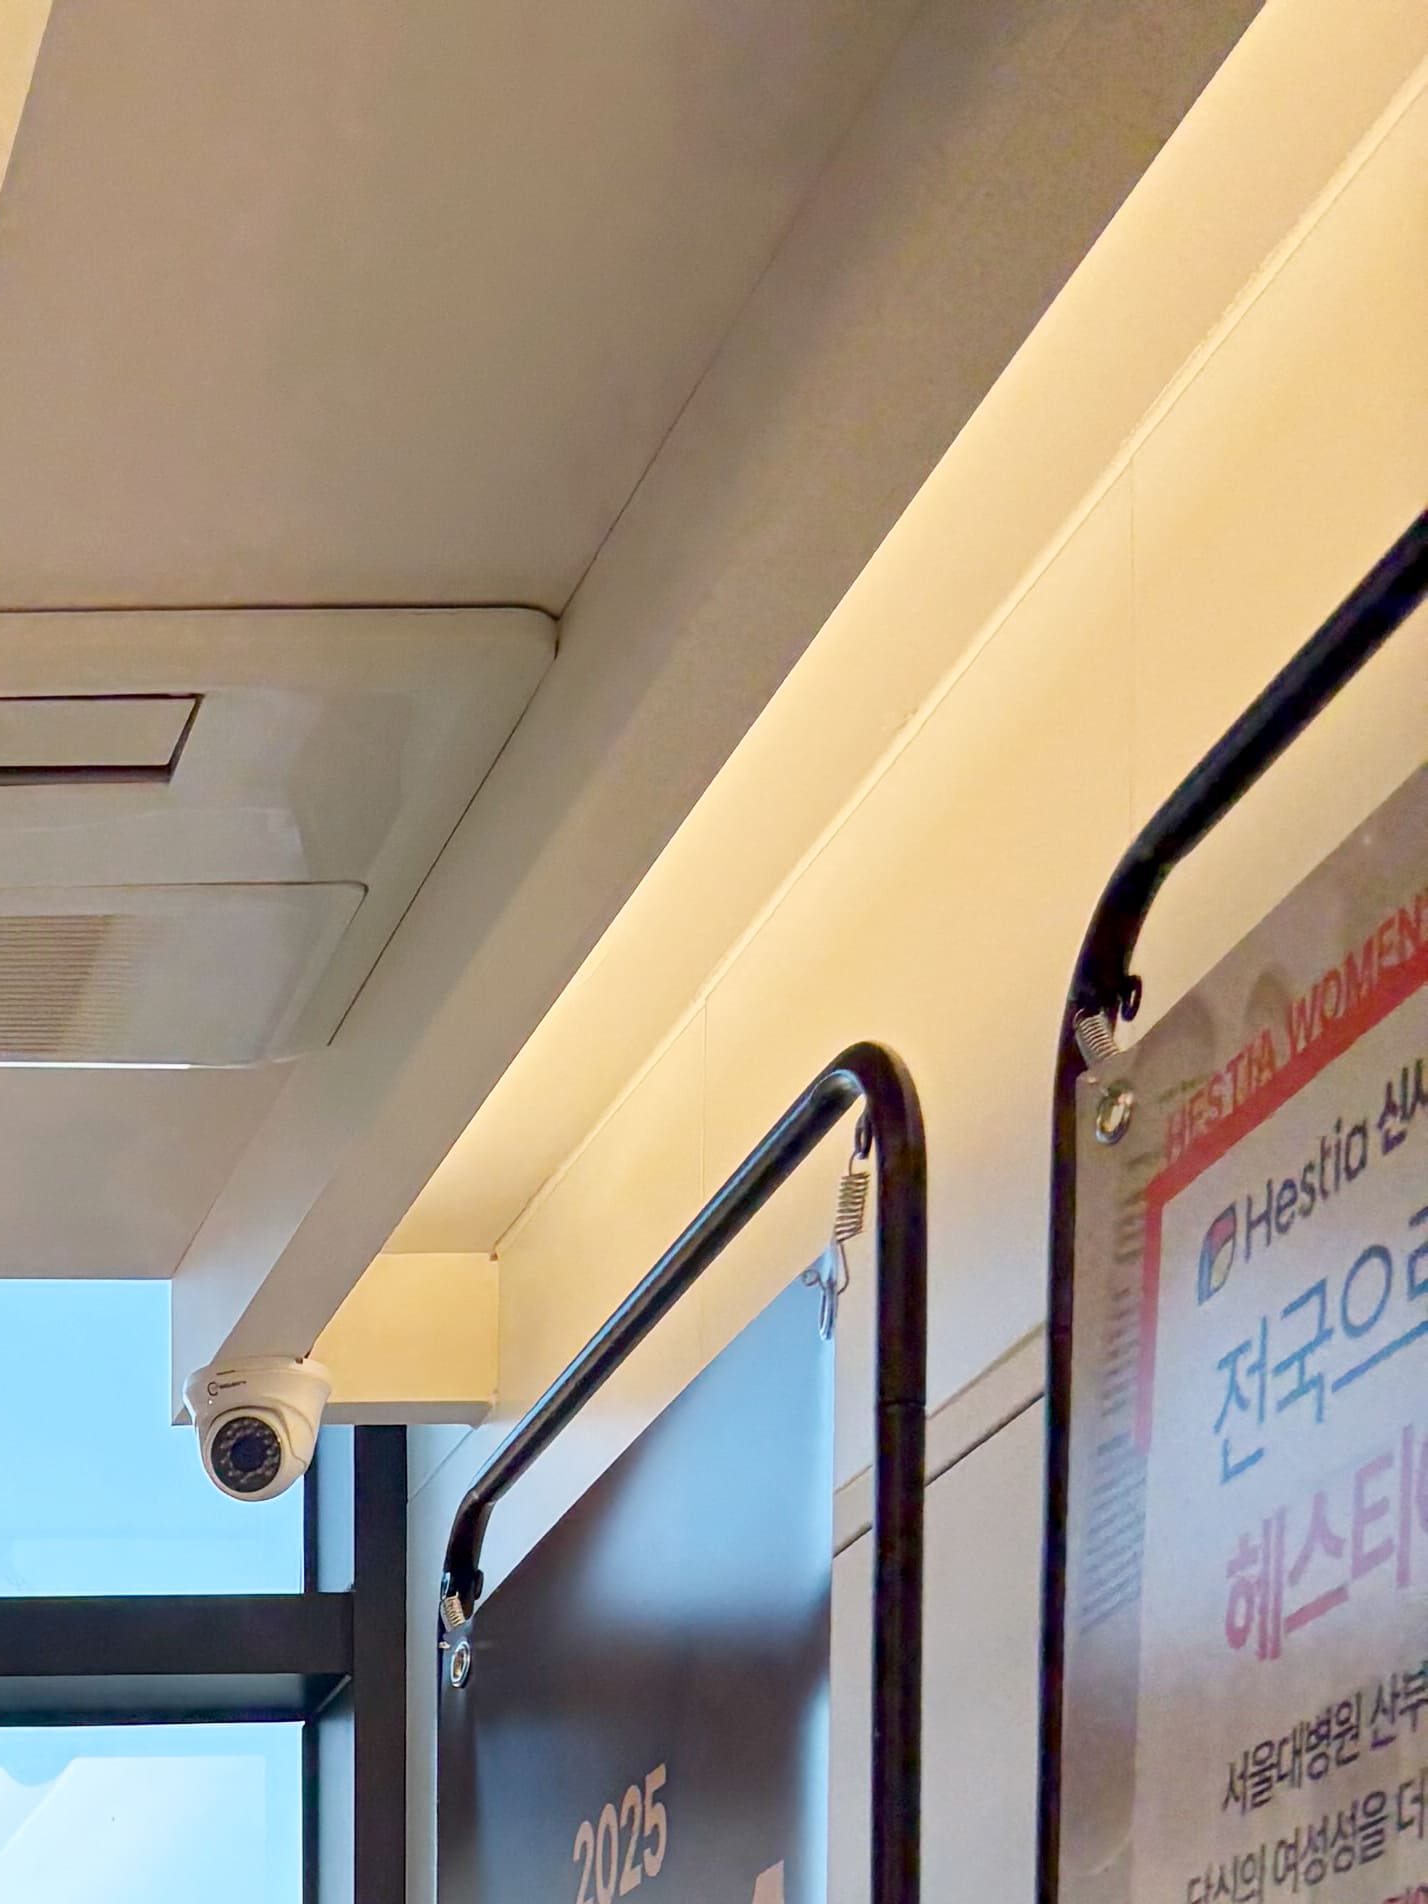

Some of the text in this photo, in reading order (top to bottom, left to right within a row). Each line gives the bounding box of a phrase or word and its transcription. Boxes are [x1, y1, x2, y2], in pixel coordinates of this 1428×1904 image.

[1166, 1029, 1277, 1165] HESTIA
[1246, 1117, 1369, 1263] Hestia
[1221, 1691, 1363, 1818] 서울대병원
[1273, 1789, 1389, 1893] 여성성을
